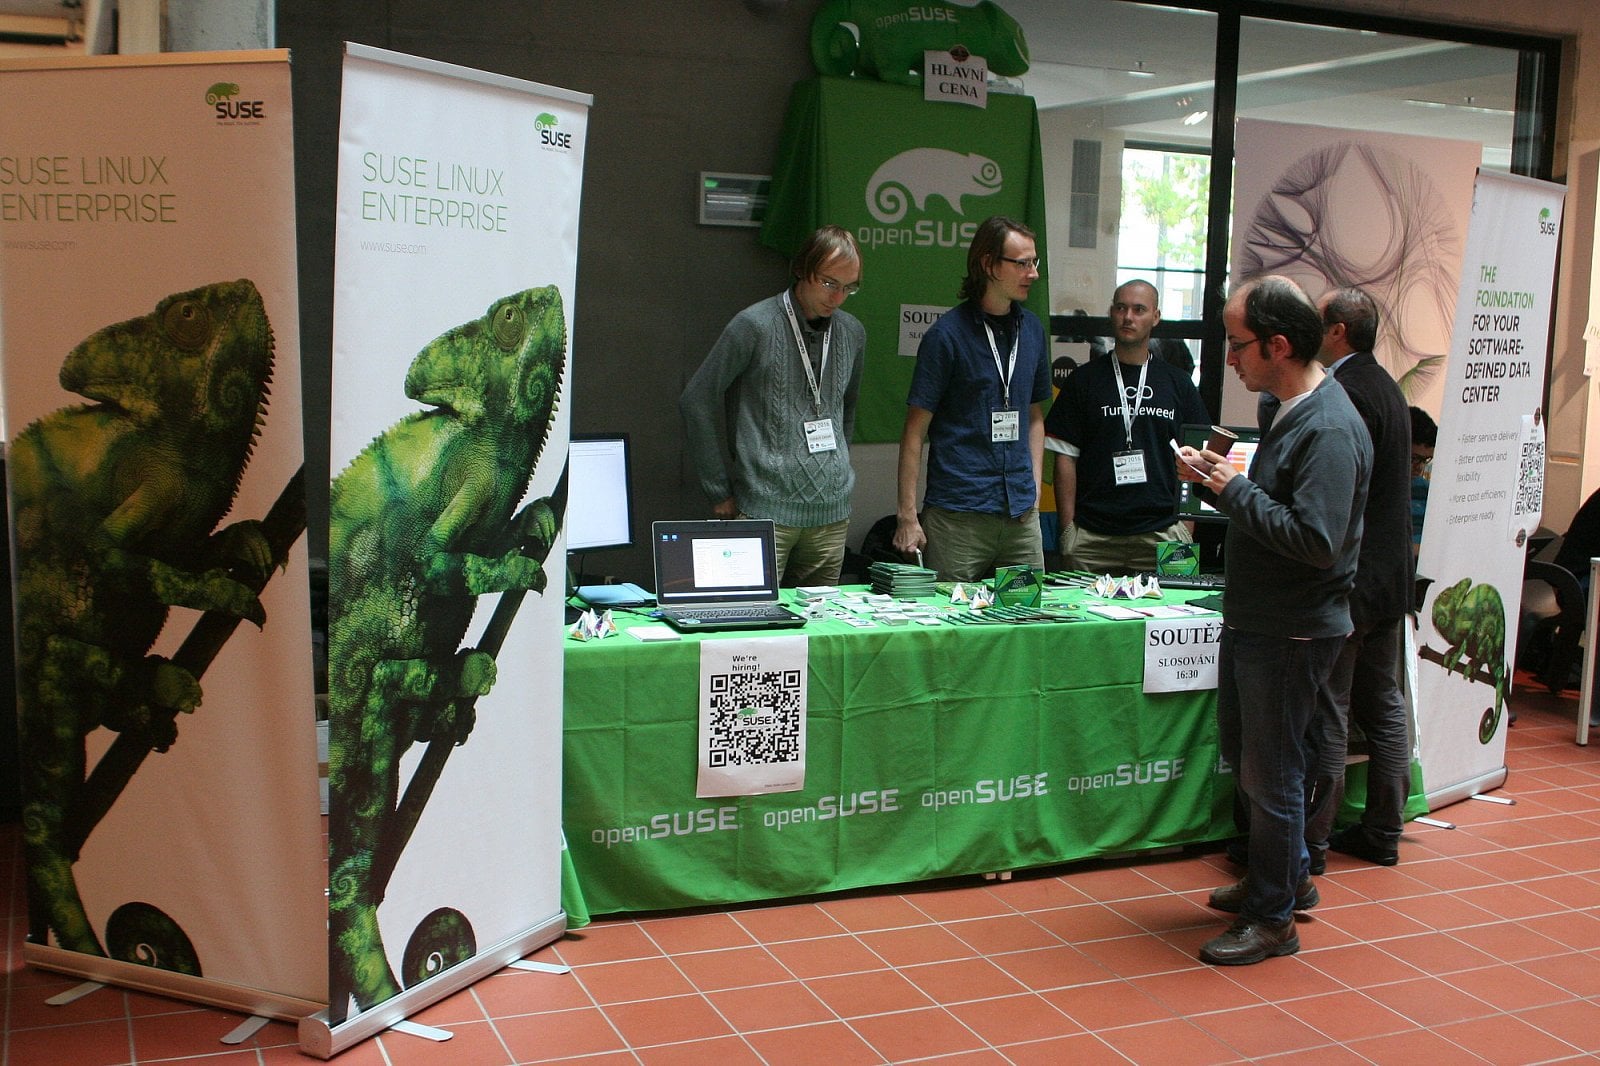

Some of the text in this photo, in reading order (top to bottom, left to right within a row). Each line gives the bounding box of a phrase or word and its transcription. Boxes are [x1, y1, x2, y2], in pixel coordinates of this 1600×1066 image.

[876, 6, 959, 28] openSUSE
[931, 63, 984, 82] HLAVNÍ
[939, 82, 979, 98] CENA
[215, 101, 265, 119] SUSE
[541, 129, 572, 149] SUSE
[0, 156, 168, 185] SUSE LINUX
[362, 152, 504, 197] SUSE LINUX
[2, 193, 177, 223] ENTERPRISE
[362, 190, 508, 233] ENTERPRISE
[858, 220, 978, 250] openSUS
[1540, 222, 1555, 235] SUSE
[360, 240, 427, 254] www.suse.com
[1480, 265, 1497, 283] THE
[1475, 289, 1534, 309] FOUNDATION
[1472, 314, 1520, 332] FOR YOUR
[1468, 338, 1524, 356] SOFTWARE-
[1465, 362, 1531, 379] DEFINED DATA
[1462, 385, 1500, 403] CENTER
[1101, 404, 1174, 421] Tubeweed
[732, 664, 760, 672] hiring!
[1158, 654, 1215, 668] SLOSOVÁNÍ
[1176, 669, 1198, 680] 16:30
[742, 716, 772, 726] SUSE
[1068, 757, 1185, 795] openSUSE
[921, 772, 1048, 812] openSUSE
[763, 788, 899, 831] openSUSE
[591, 806, 738, 849] openSUSE
